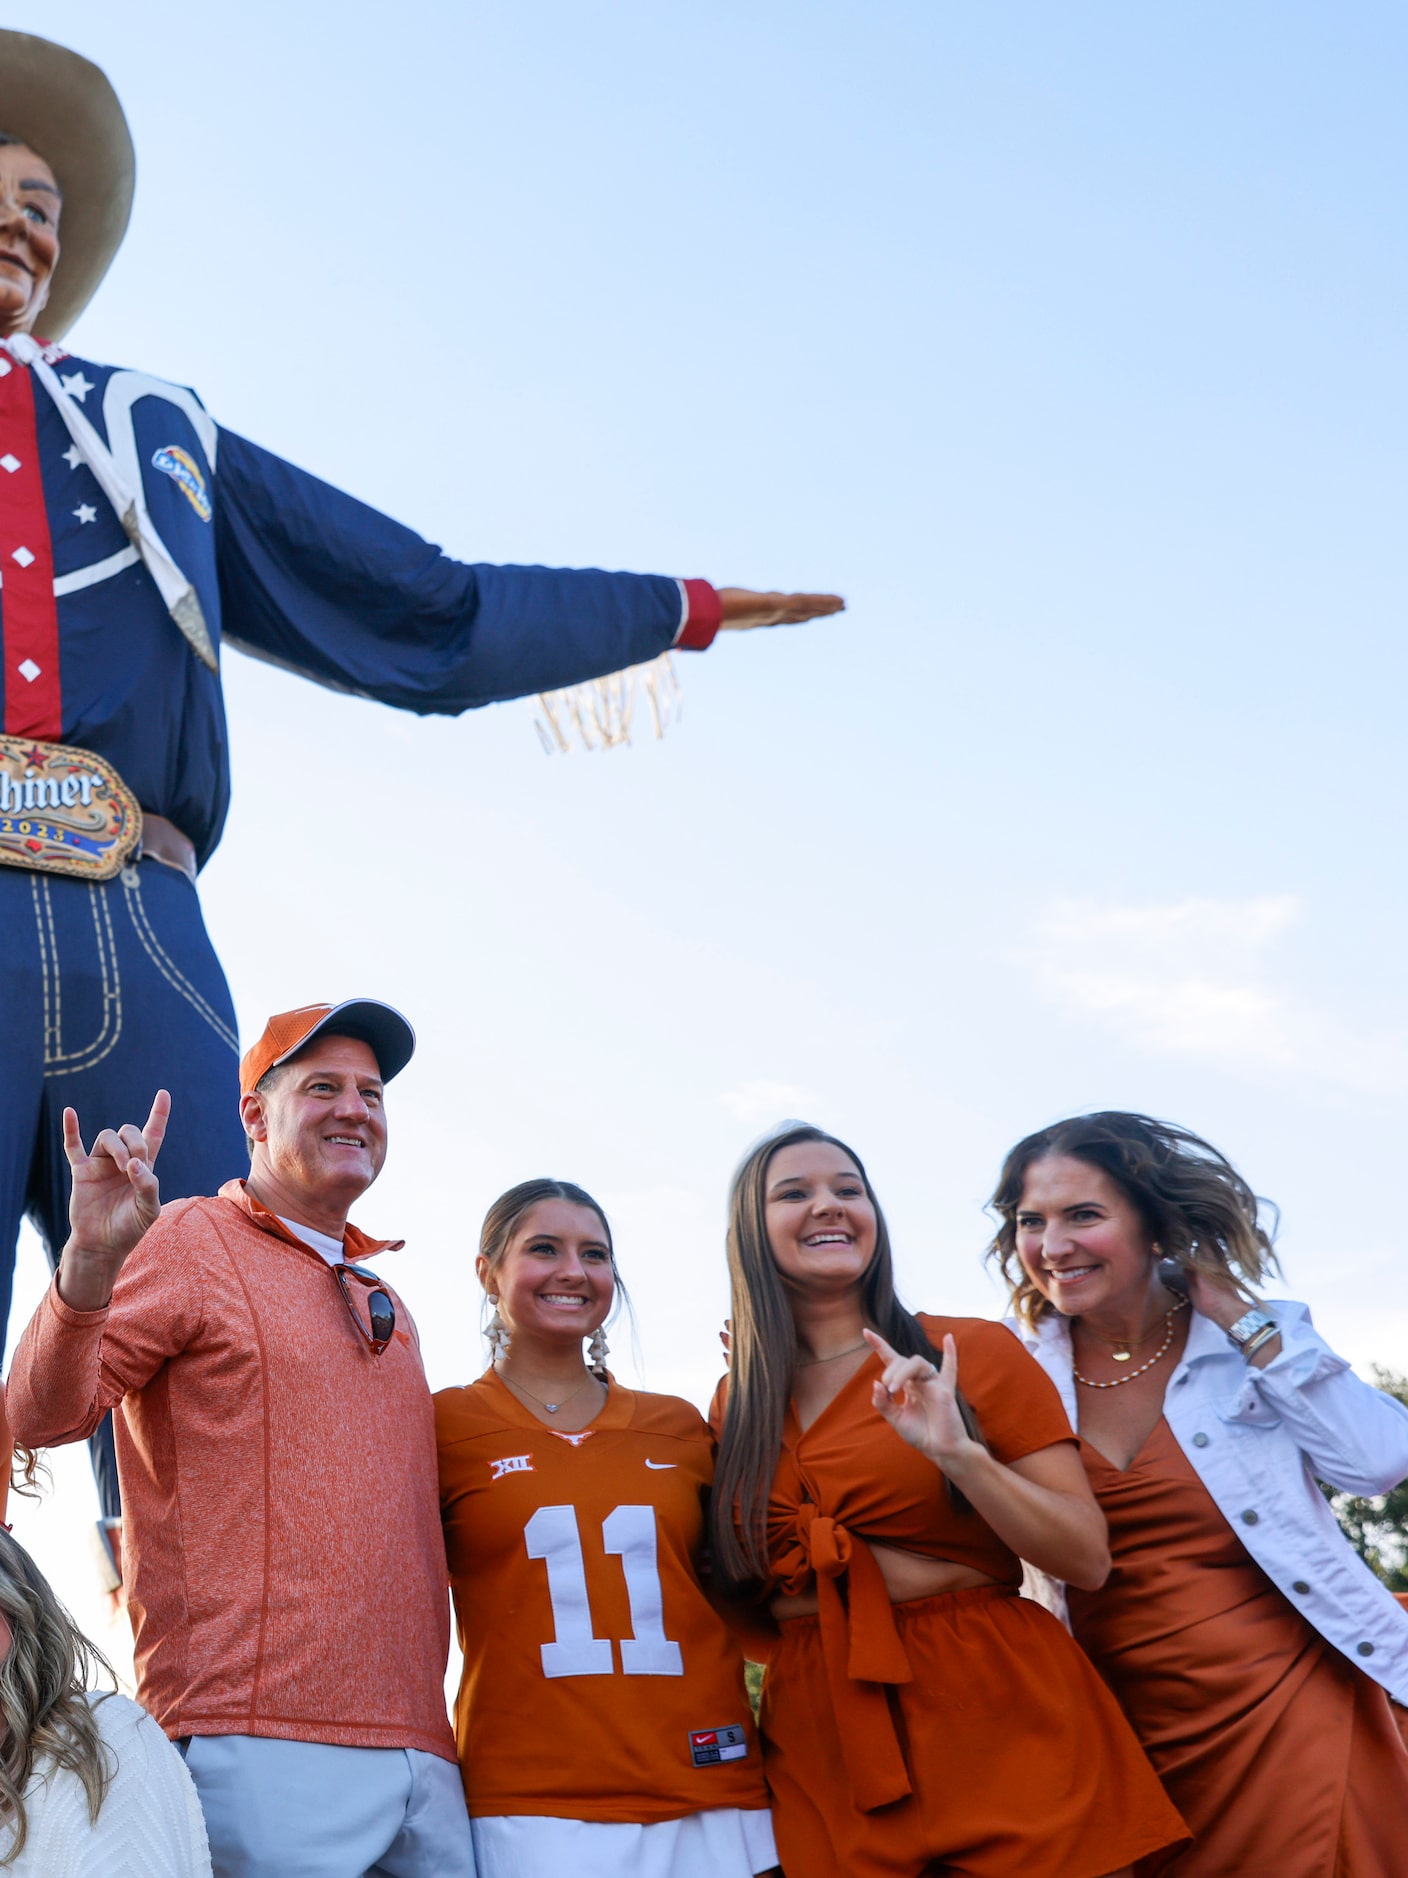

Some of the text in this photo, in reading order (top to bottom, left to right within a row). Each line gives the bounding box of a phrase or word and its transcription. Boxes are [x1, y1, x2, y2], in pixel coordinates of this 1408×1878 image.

[1, 819, 65, 843] 2023
[489, 1453, 535, 1481] XII
[523, 1504, 685, 1679] 11
[727, 1731, 736, 1743] S
